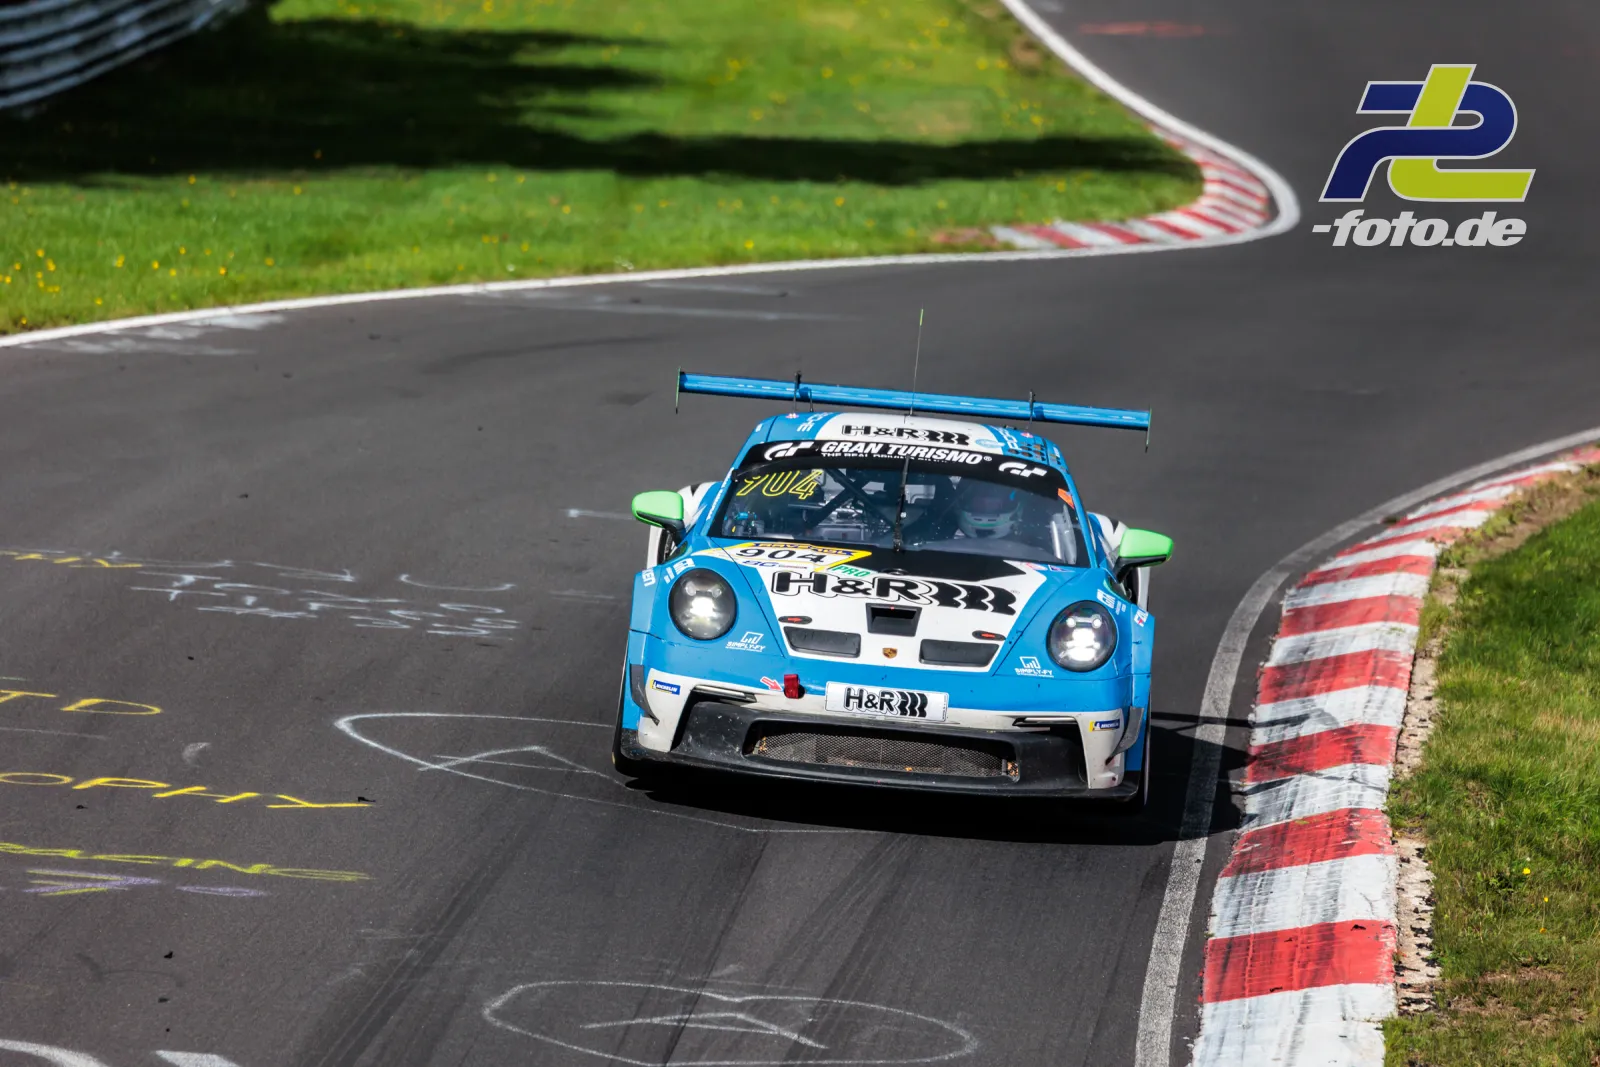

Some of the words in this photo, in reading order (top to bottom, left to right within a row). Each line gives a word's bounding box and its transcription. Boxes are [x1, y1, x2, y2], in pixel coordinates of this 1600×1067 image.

[842, 424, 928, 443] H&R
[821, 441, 881, 454] GRAN
[735, 548, 828, 563] 904
[832, 565, 871, 578] PRO
[772, 571, 938, 606] H&R
[844, 686, 902, 716] H&R
